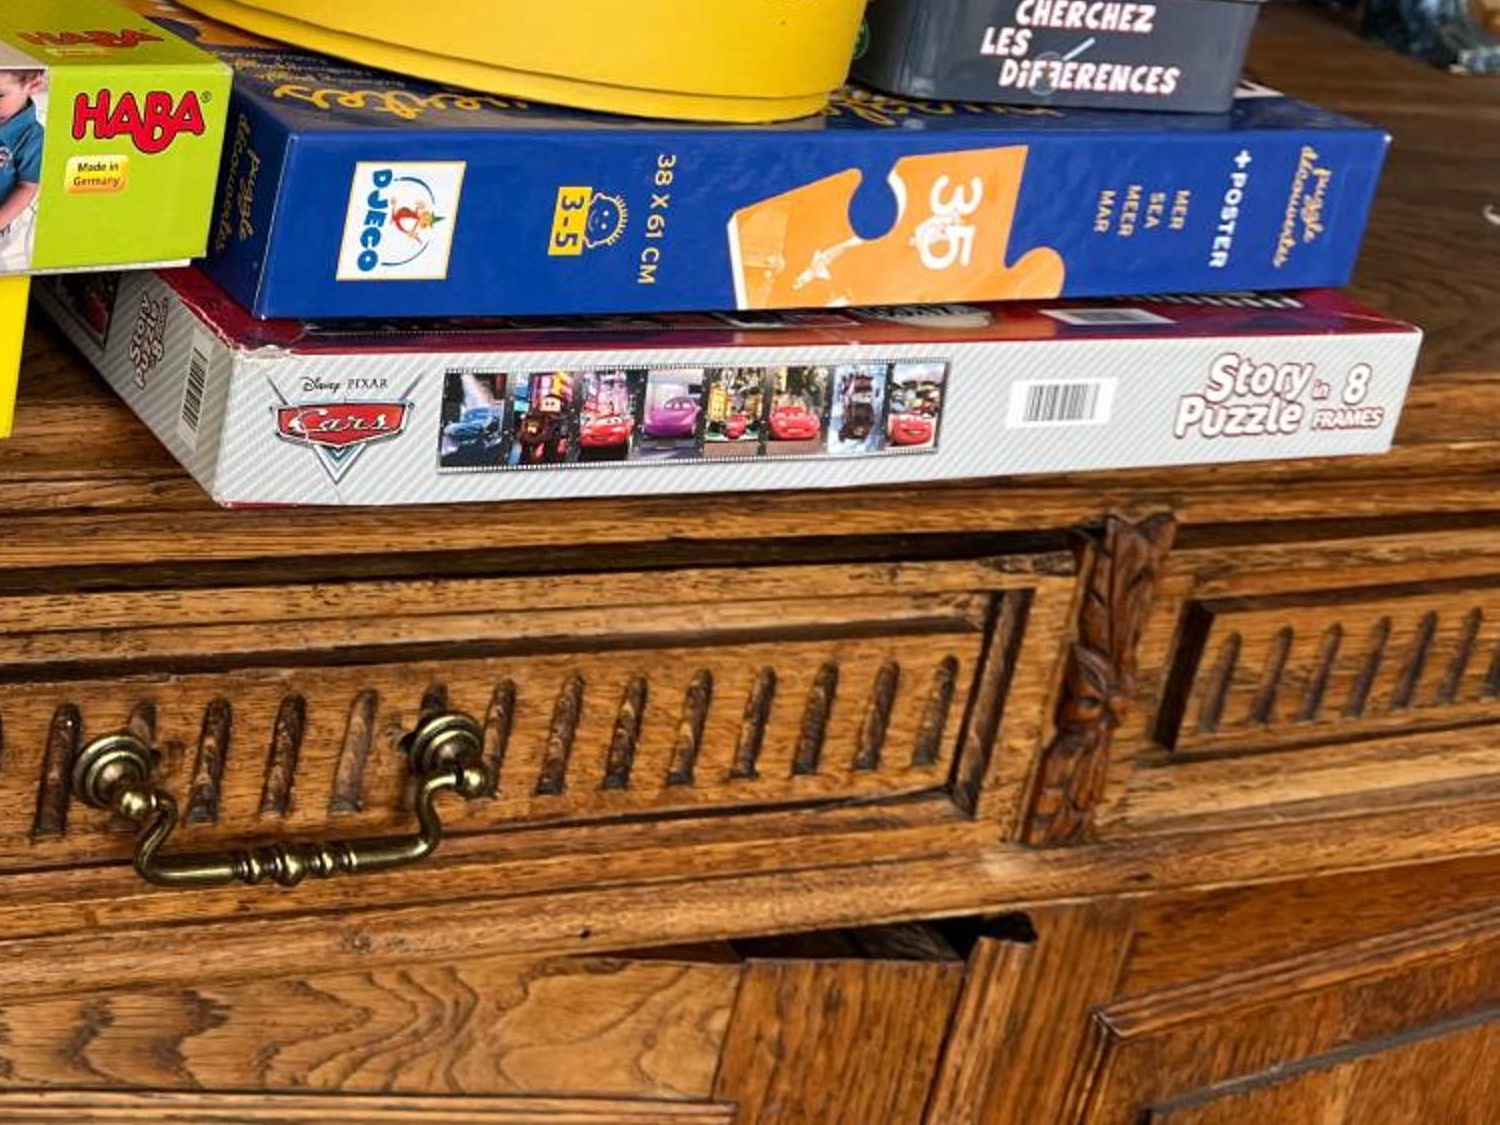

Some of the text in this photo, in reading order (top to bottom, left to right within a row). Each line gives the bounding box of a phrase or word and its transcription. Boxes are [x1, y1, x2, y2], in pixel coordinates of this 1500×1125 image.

[980, 26, 1034, 57] LES
[72, 89, 206, 155] HABA
[73, 176, 120, 188] Germany
[77, 161, 119, 172] Made in
[357, 169, 393, 272] DJECO
[637, 154, 677, 284] 38 X 61 CM
[915, 174, 983, 270] 35
[1093, 190, 1117, 233] MAR
[1117, 185, 1143, 236] MEER
[1144, 192, 1167, 229] SEA
[1169, 190, 1191, 230] MER
[301, 376, 388, 393] Disney PIXAR
[1203, 352, 1372, 405] Story in 8
[287, 408, 389, 434] Cars
[1173, 393, 1385, 439] Puzzle FRAMES
